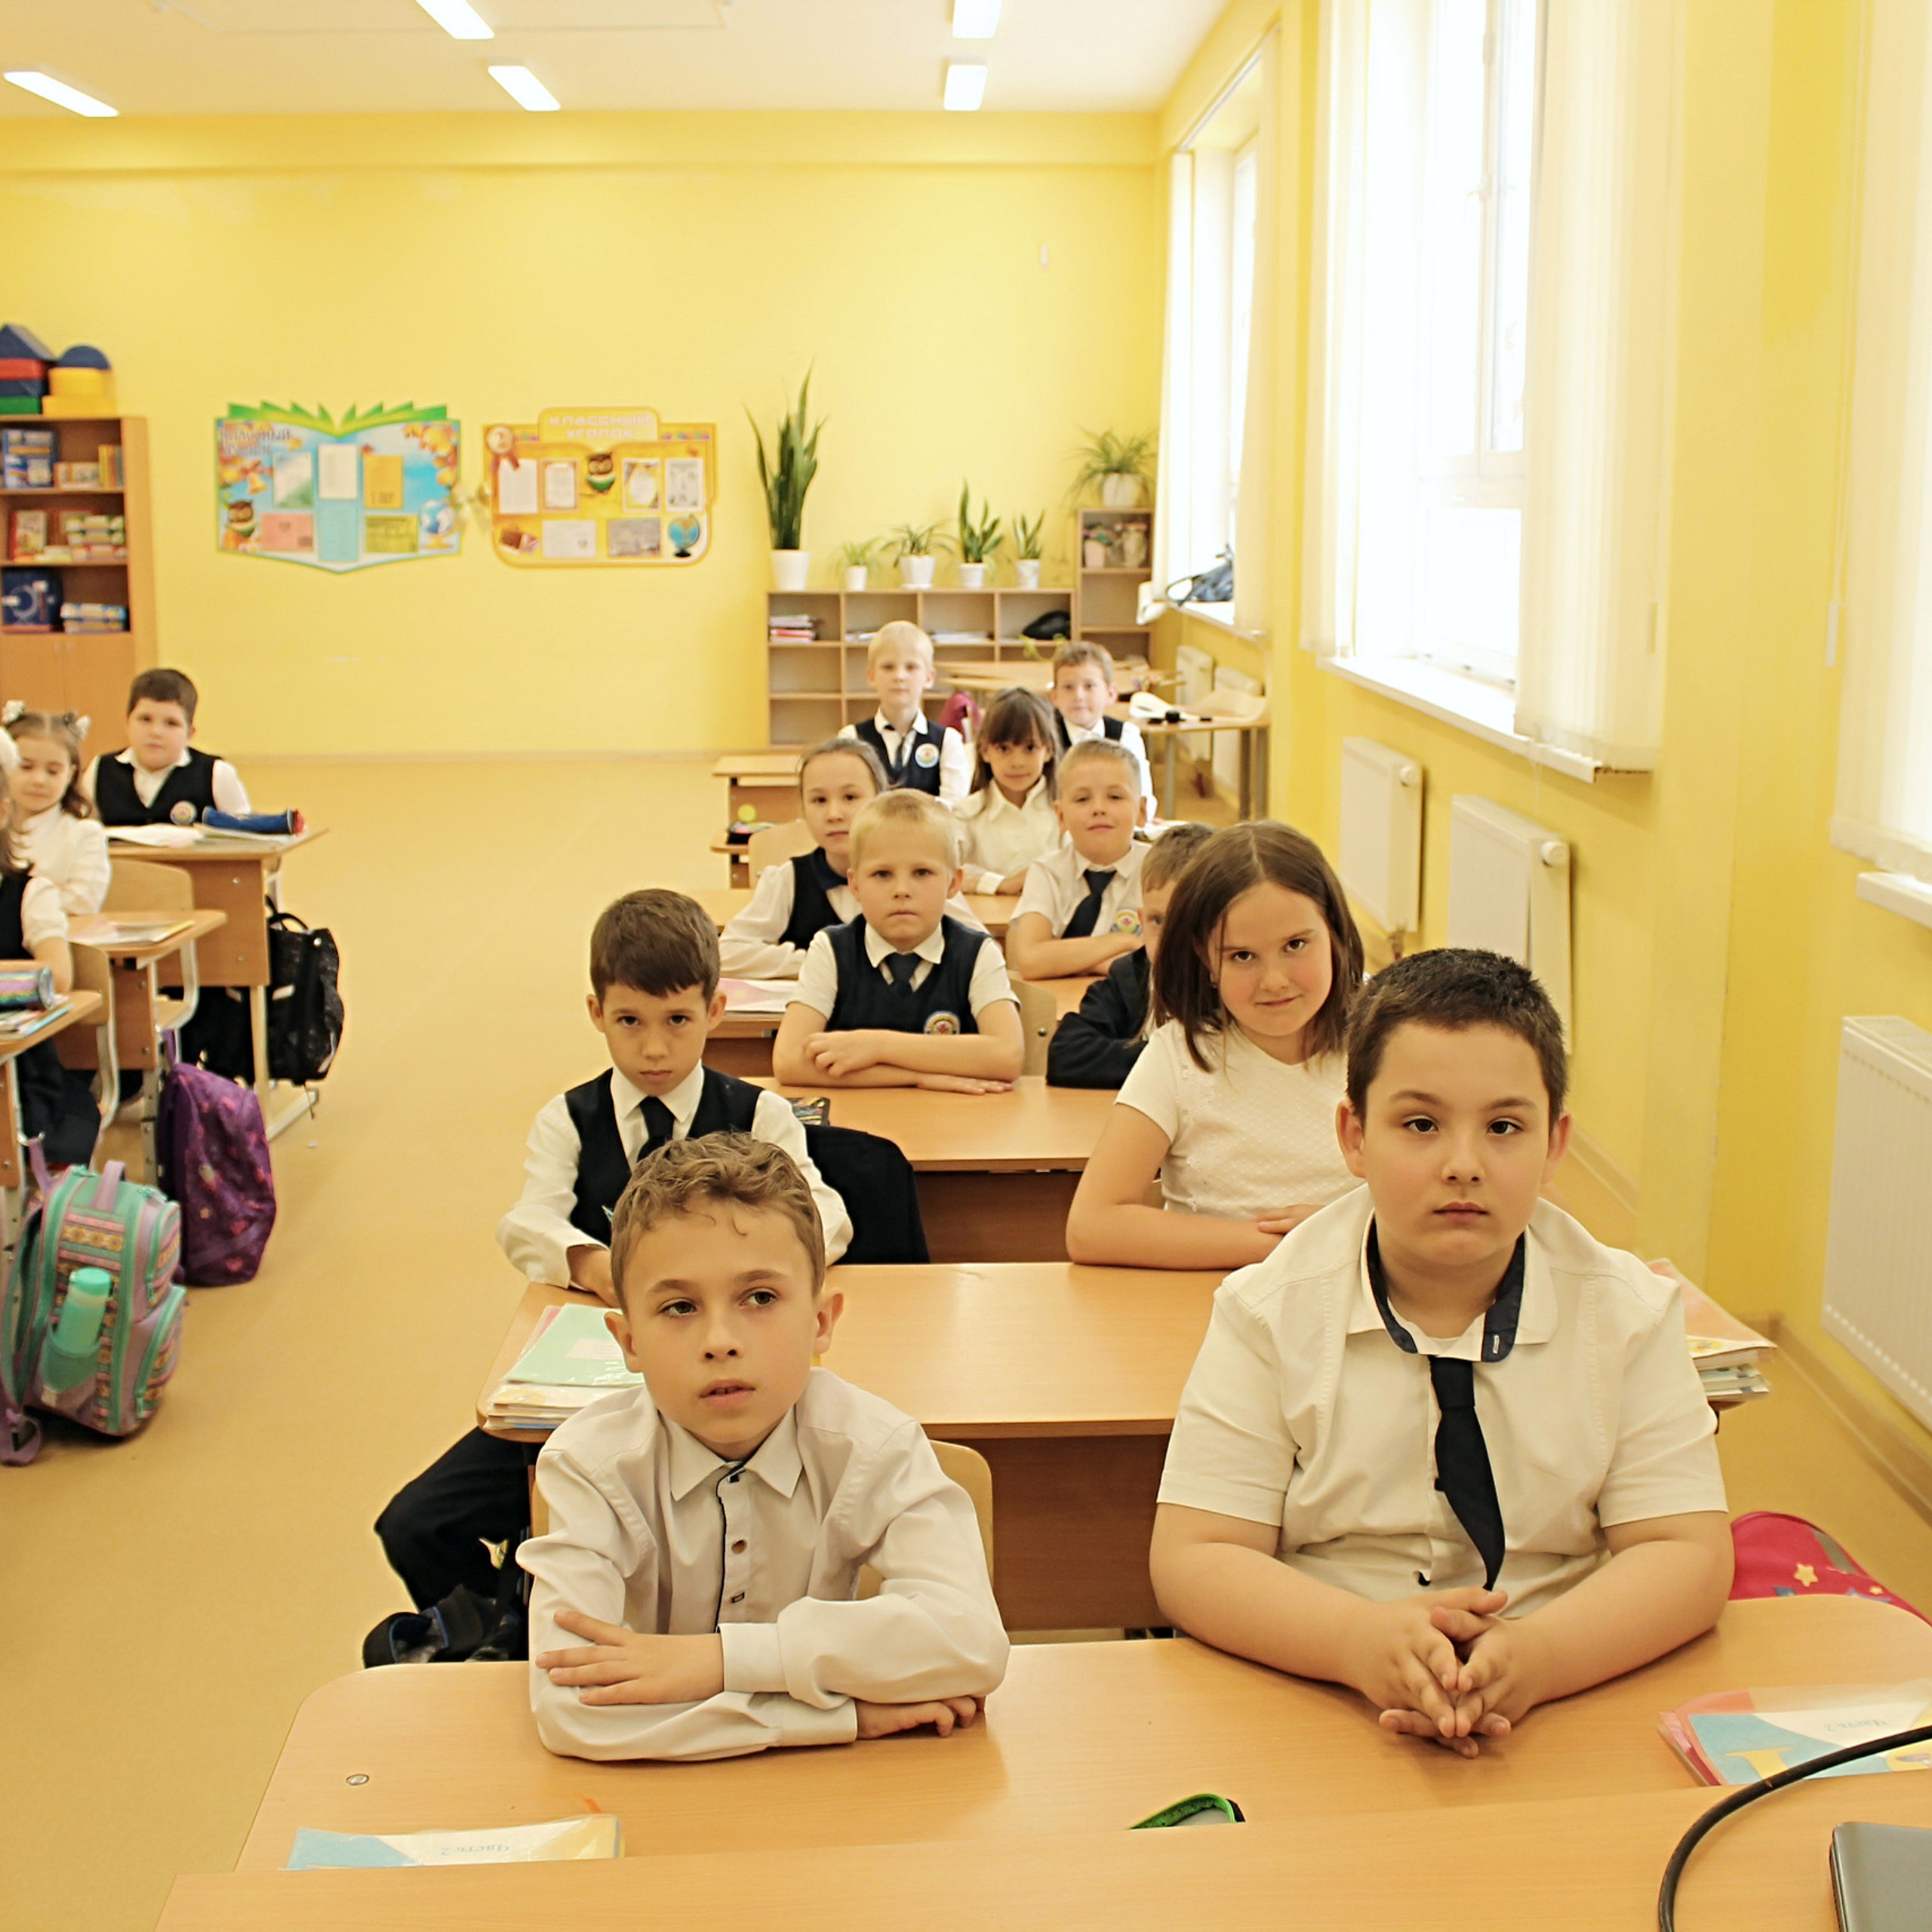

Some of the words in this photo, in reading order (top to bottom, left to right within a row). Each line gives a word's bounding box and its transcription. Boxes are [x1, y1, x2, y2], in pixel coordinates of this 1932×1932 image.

[550, 412, 651, 426] КЛАССНЫЙ
[566, 429, 635, 440] УГОЛОК
[1838, 1720, 1888, 1729] Часть
[441, 1847, 451, 1857] 2
[457, 1844, 509, 1853] Часть
